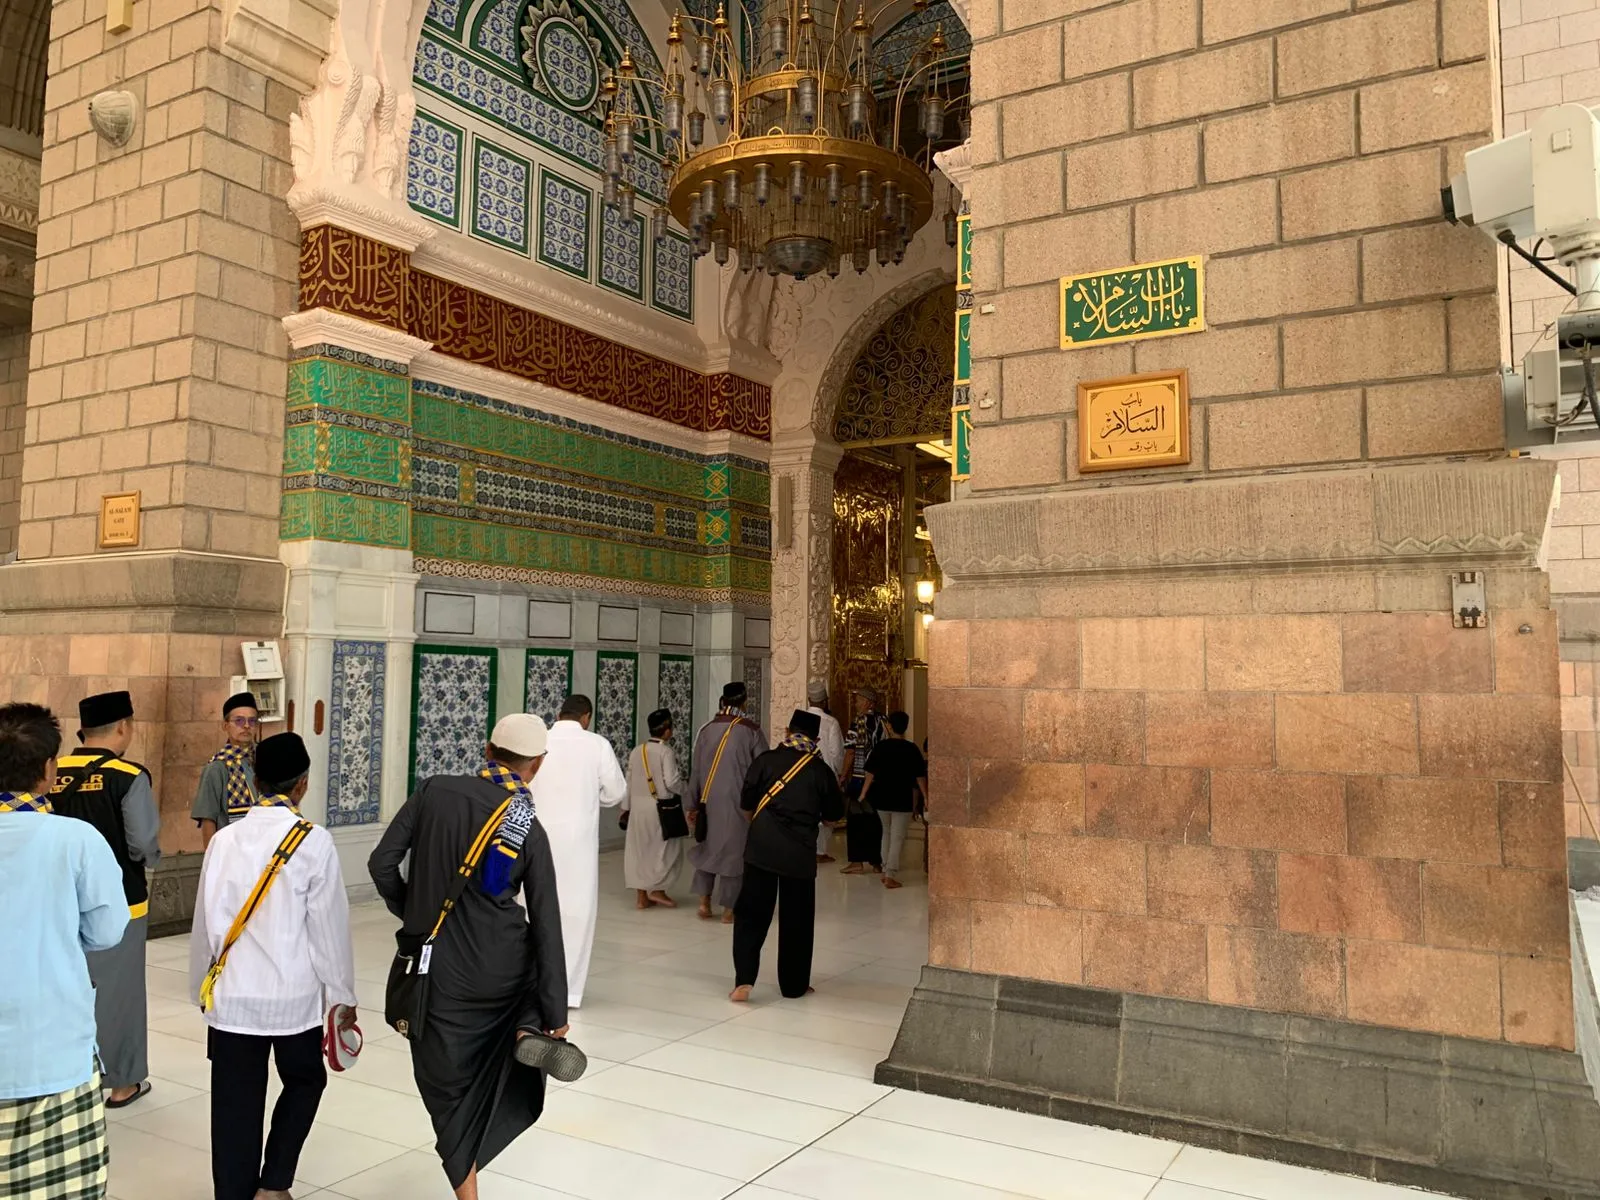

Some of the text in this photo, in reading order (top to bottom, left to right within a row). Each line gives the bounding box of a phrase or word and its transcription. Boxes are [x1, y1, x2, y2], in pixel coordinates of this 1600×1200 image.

[1121, 392, 1142, 408] باب
[1100, 404, 1165, 439] السلام
[55, 774, 103, 785] TOR
